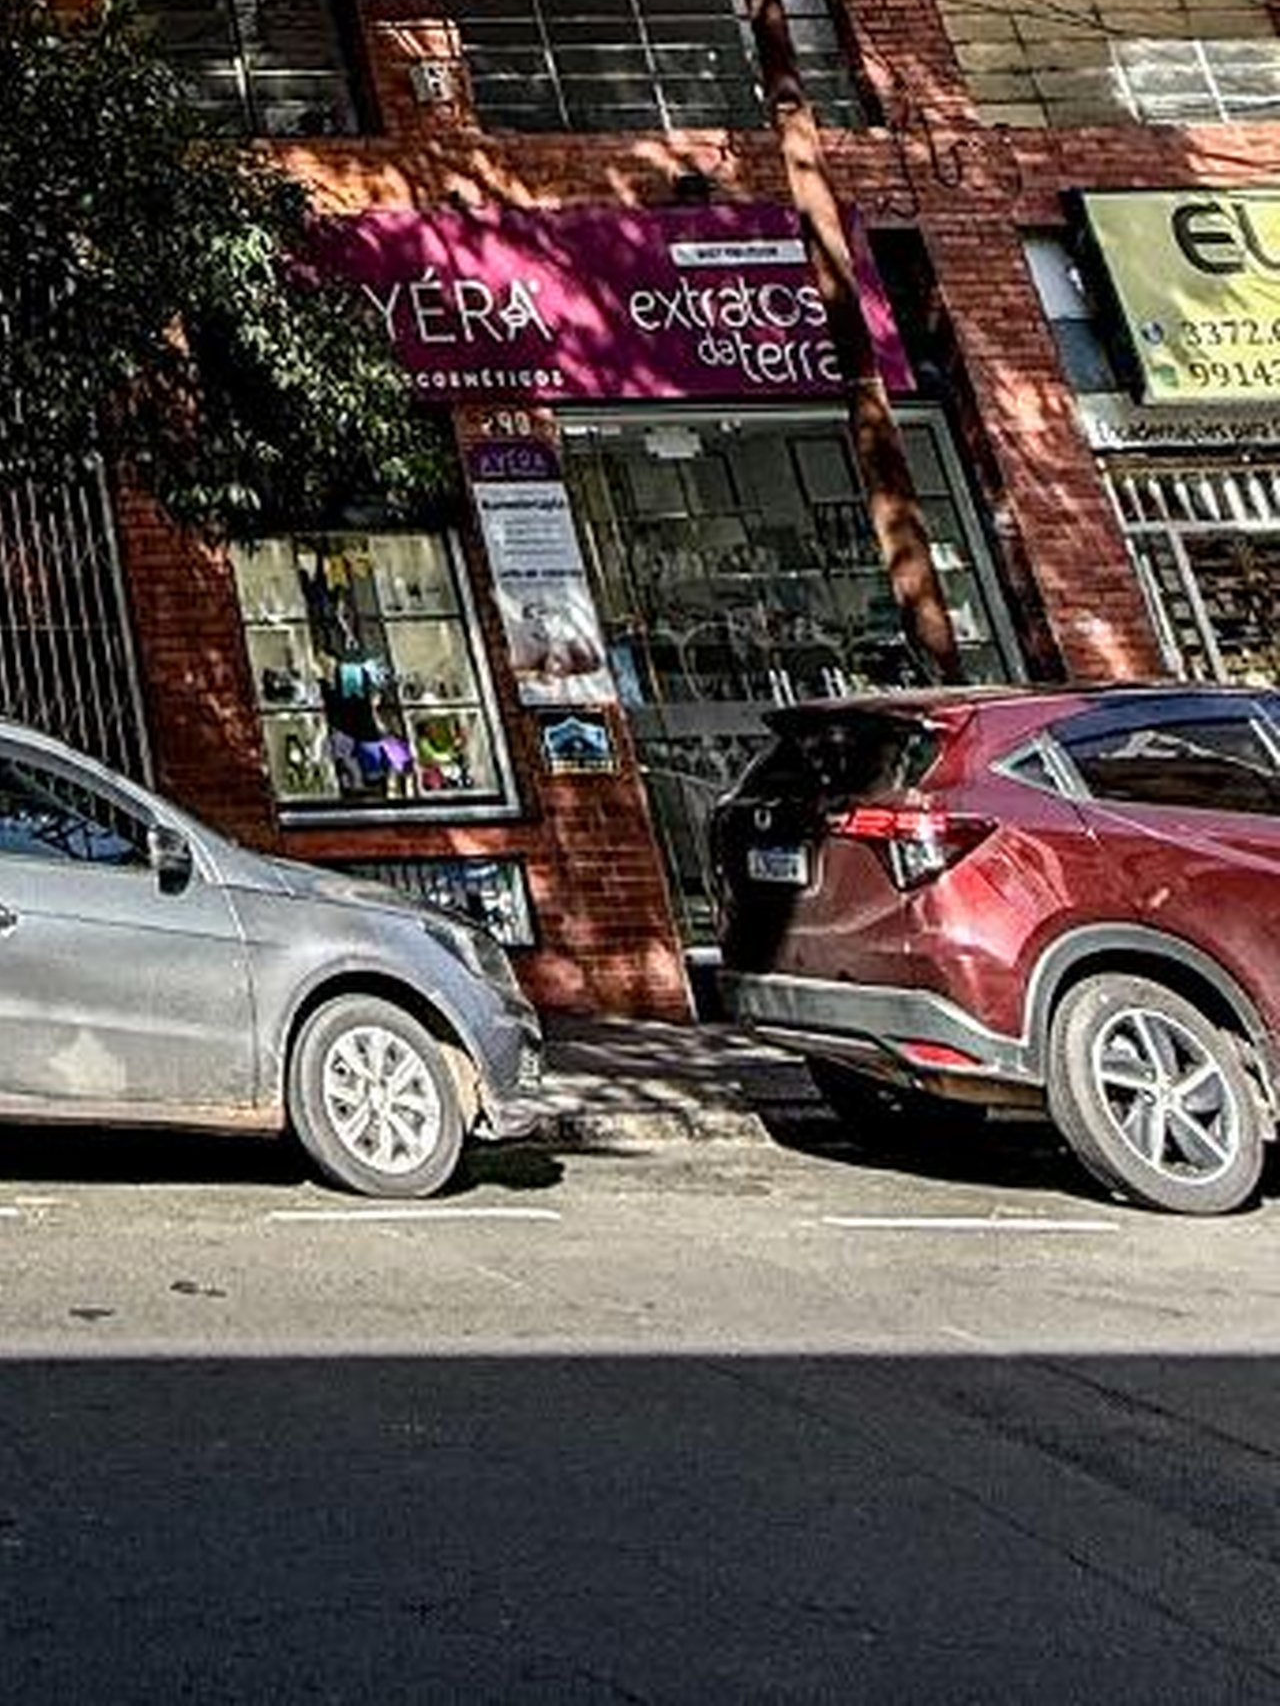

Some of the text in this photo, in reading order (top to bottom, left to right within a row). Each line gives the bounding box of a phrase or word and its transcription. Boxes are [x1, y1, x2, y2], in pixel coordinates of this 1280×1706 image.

[630, 277, 827, 332] extratos
[697, 331, 843, 384] da terra
